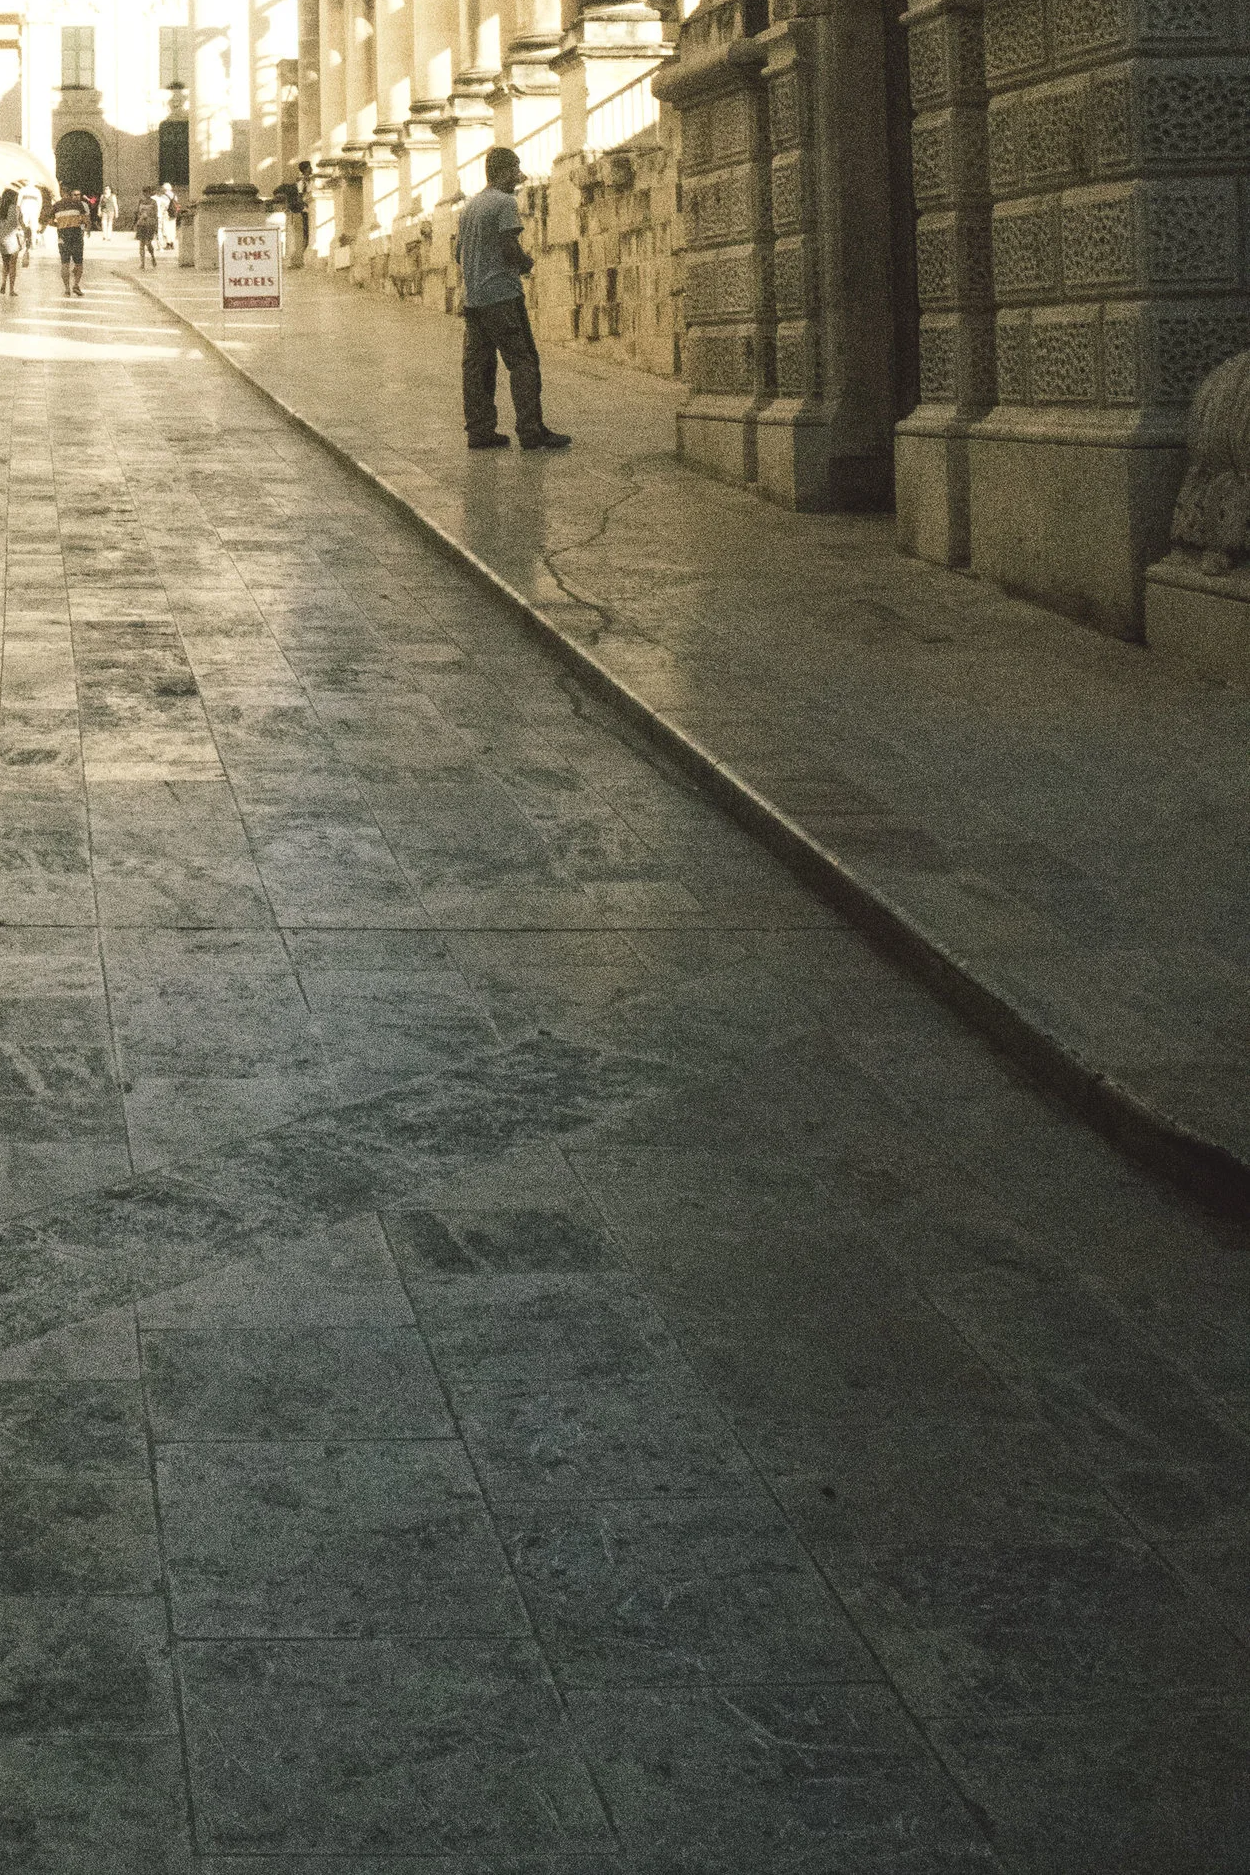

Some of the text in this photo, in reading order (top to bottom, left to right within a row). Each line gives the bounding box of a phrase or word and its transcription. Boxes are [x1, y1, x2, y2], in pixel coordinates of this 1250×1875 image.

[237, 236, 266, 246] TOYS
[231, 250, 271, 261] GAMES
[228, 276, 275, 287] MODELS
